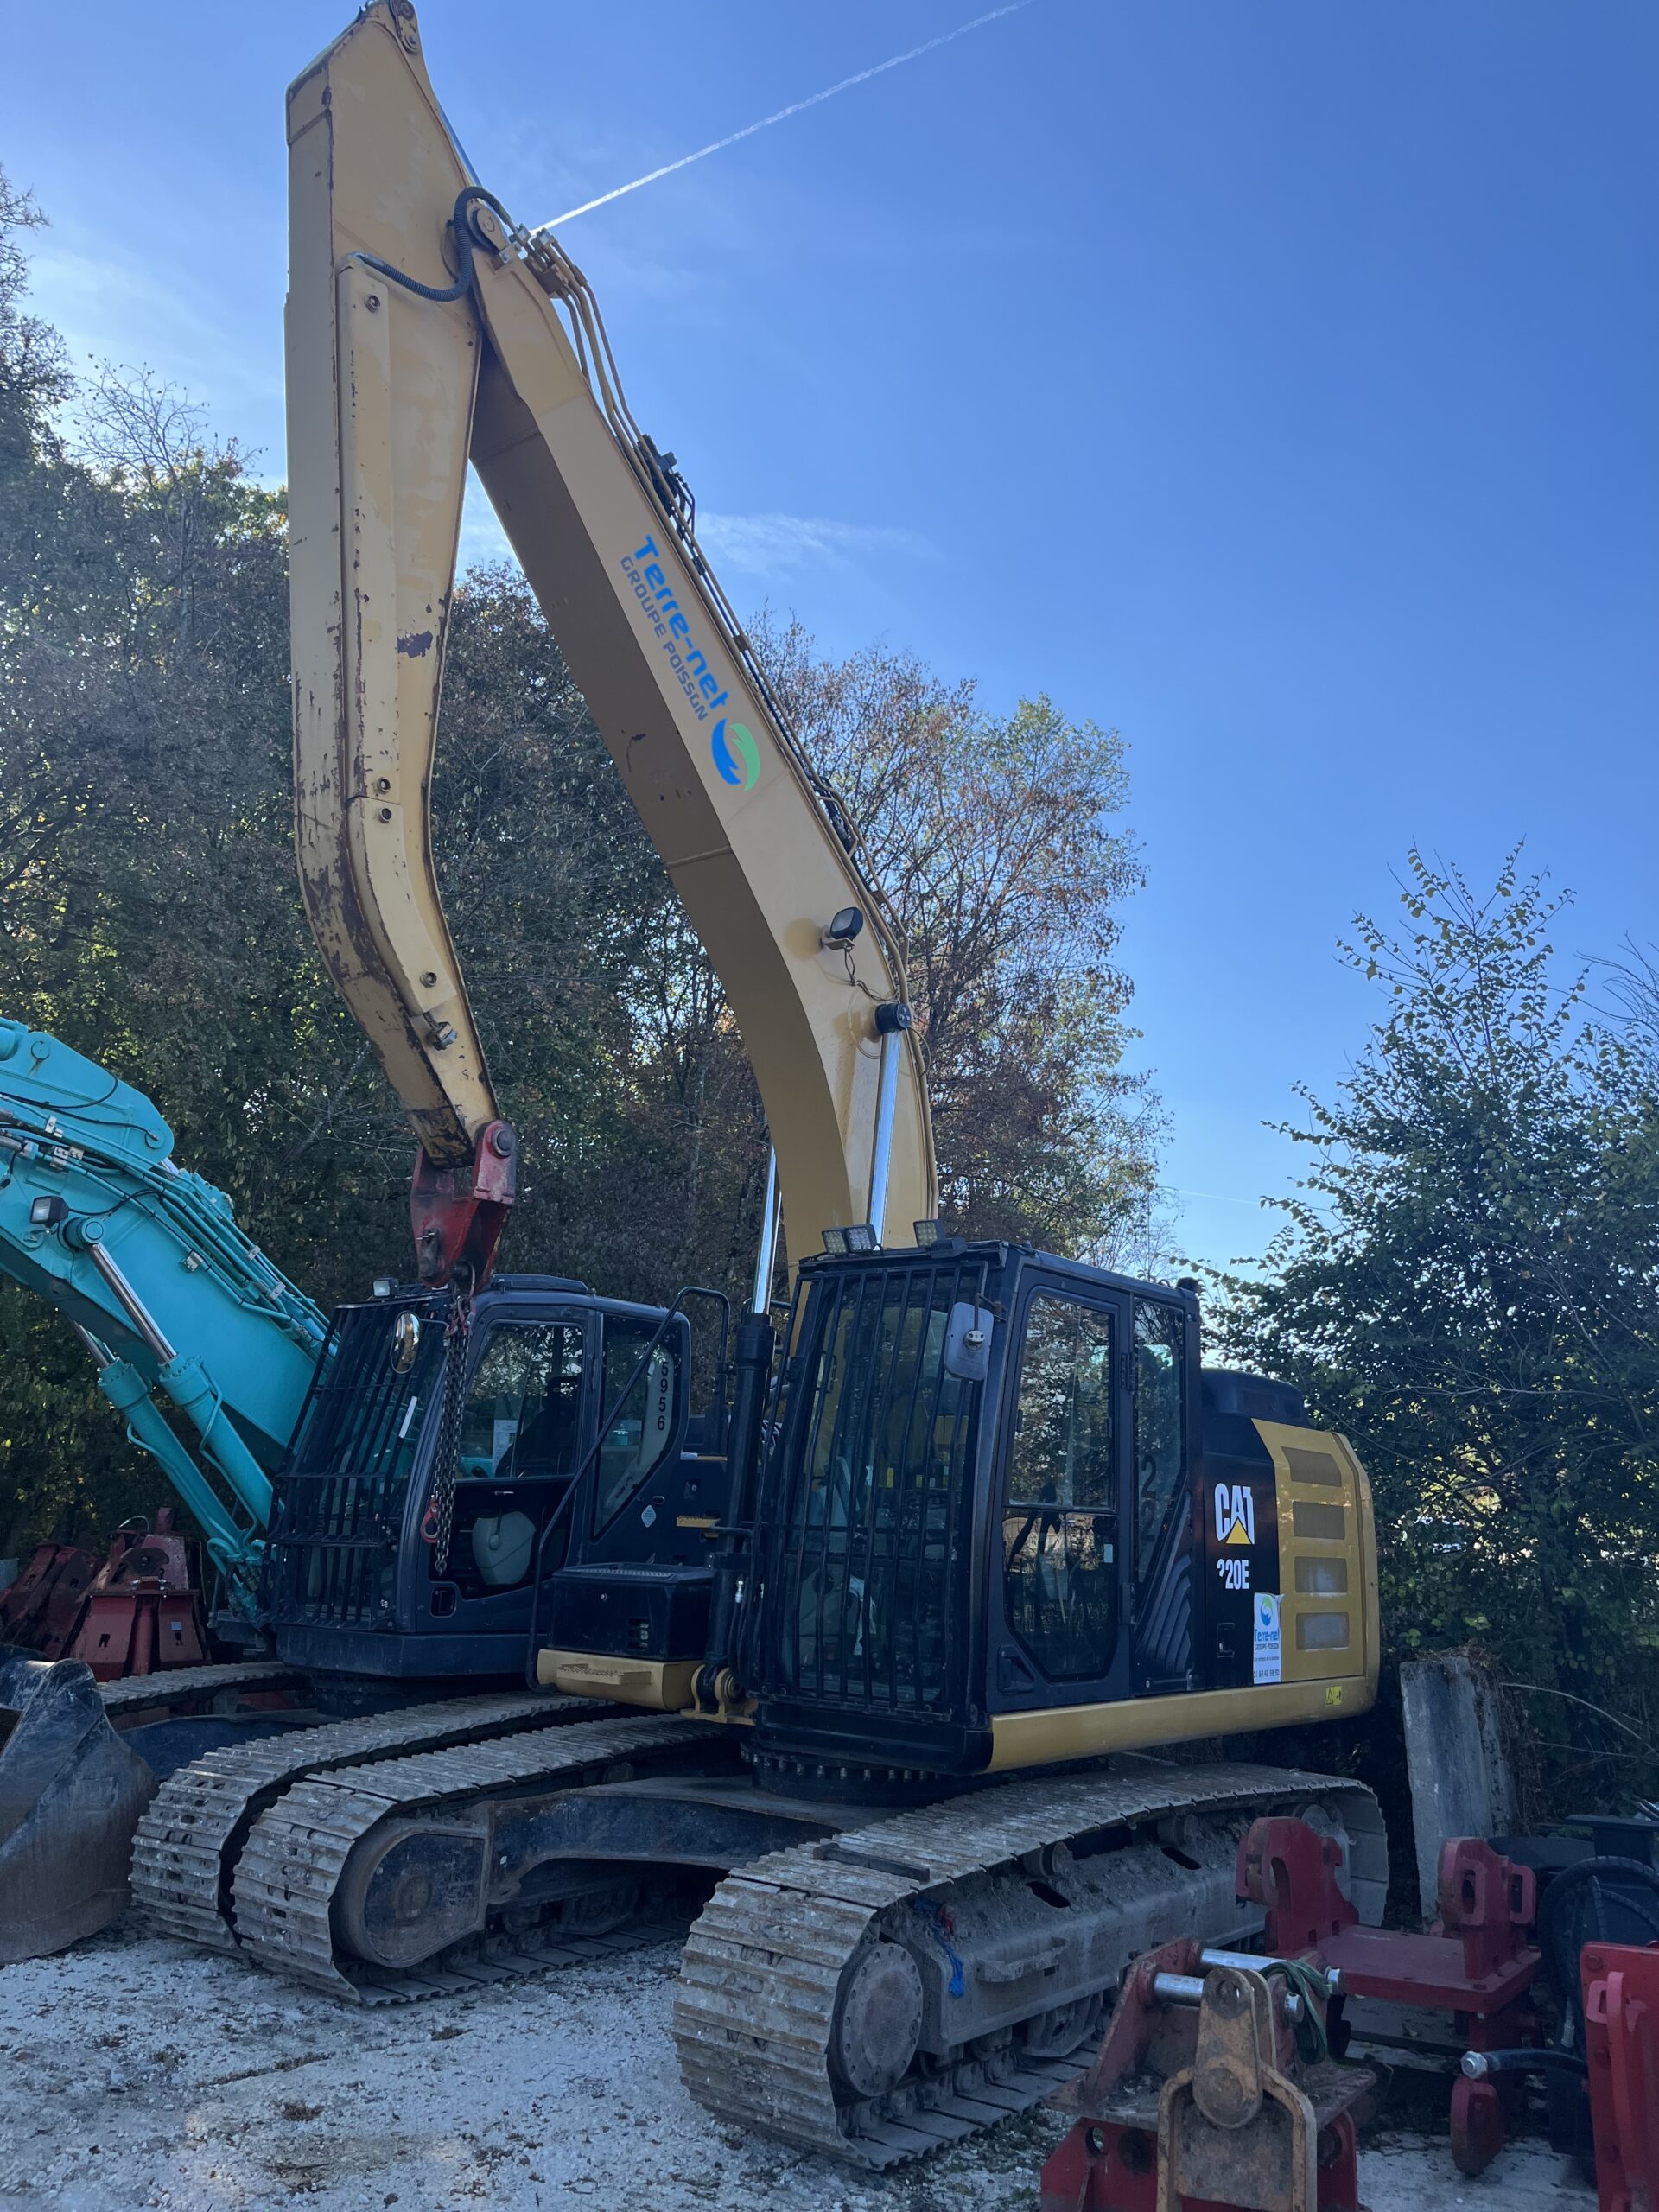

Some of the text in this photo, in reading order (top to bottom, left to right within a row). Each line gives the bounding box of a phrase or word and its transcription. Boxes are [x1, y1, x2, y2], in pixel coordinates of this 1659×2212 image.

[620, 556, 709, 721] GROUPE POISSON
[634, 534, 729, 710] Terre-net
[656, 1362, 669, 1431] 5956
[1214, 1483, 1255, 1544] CAT
